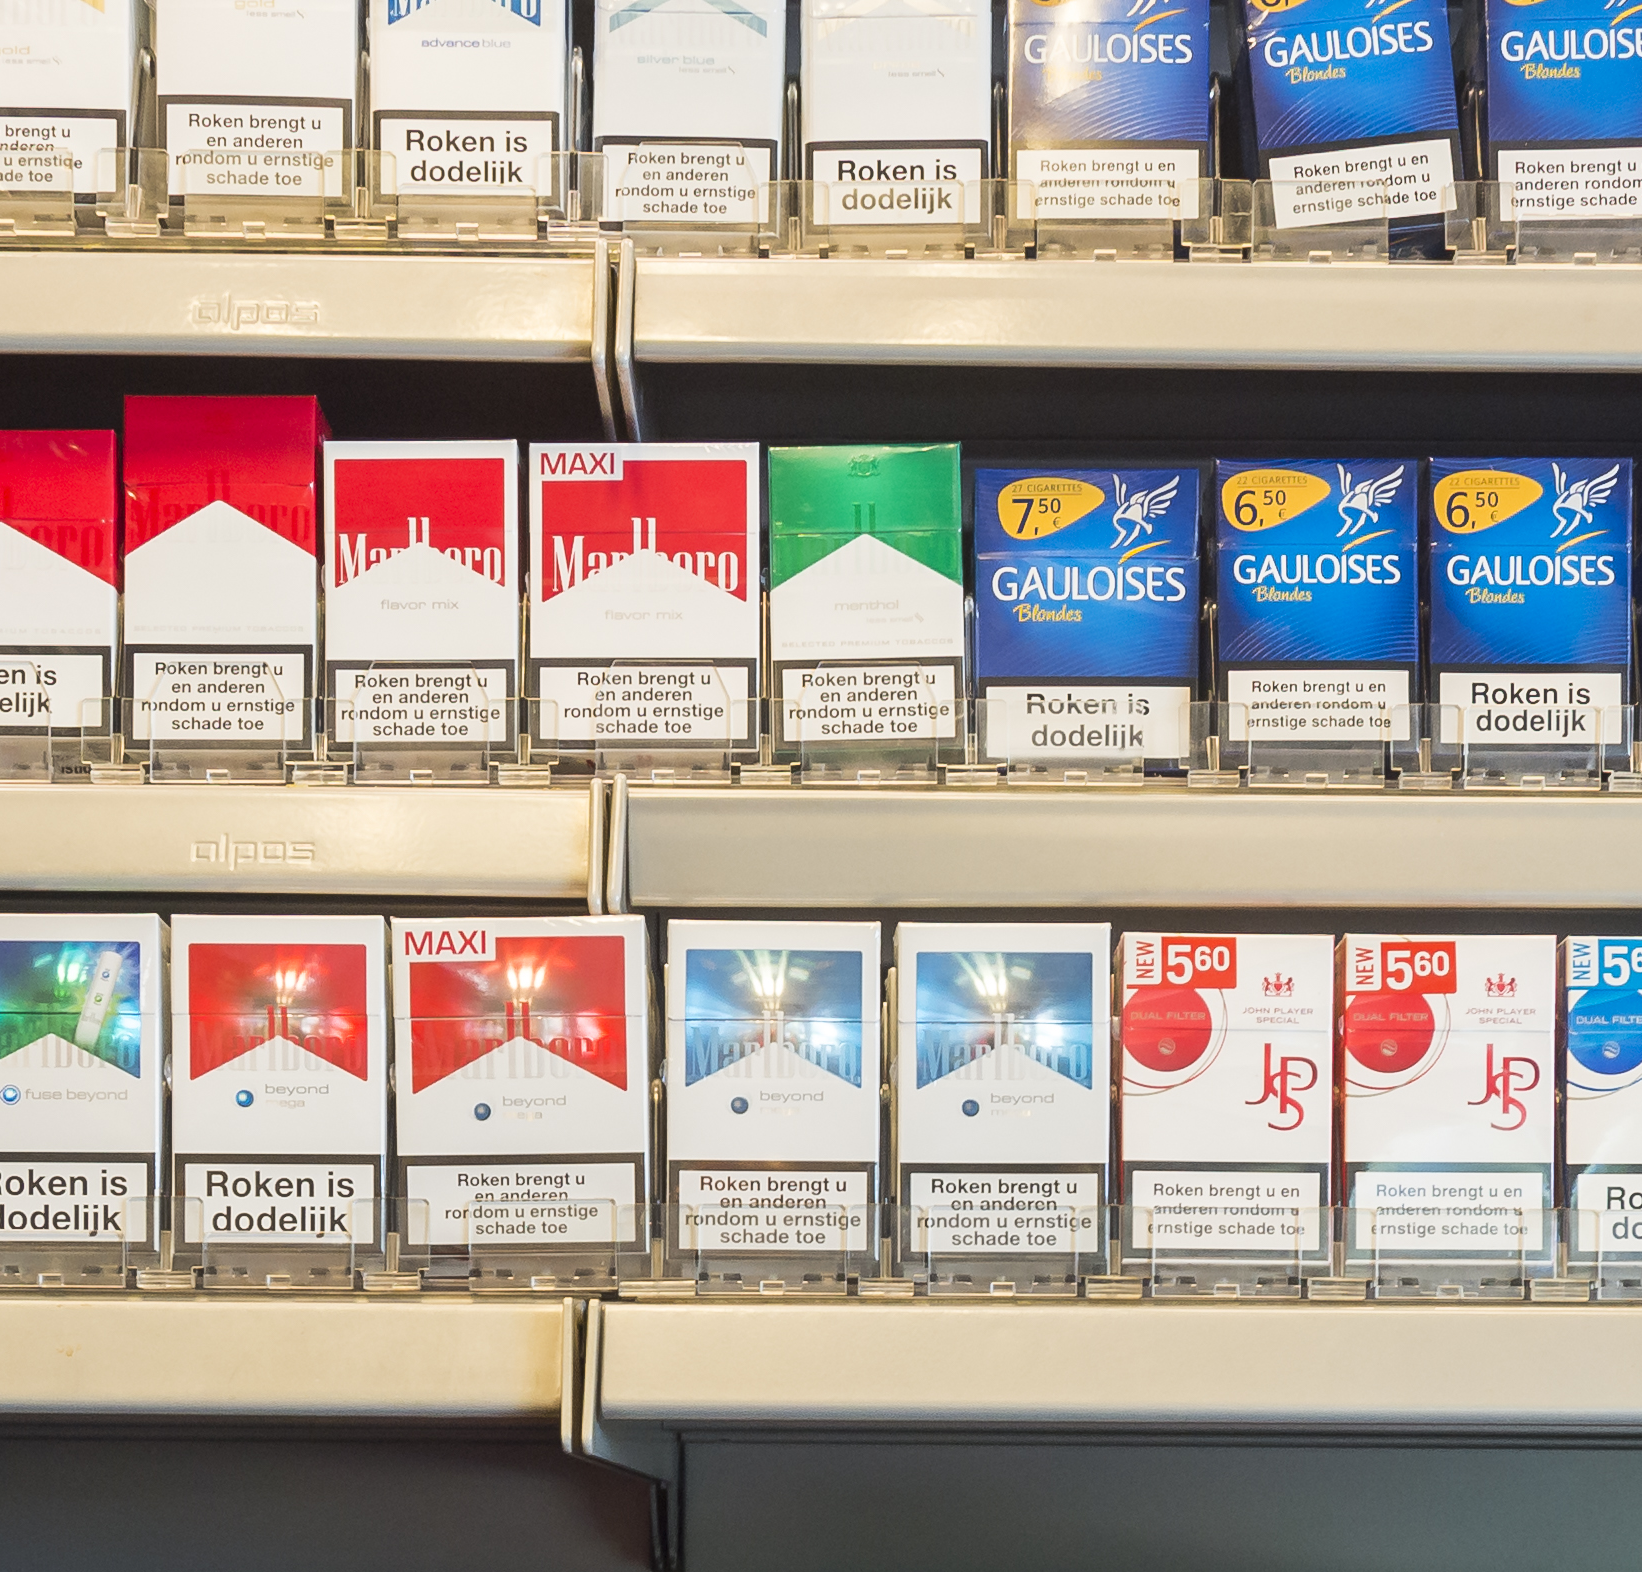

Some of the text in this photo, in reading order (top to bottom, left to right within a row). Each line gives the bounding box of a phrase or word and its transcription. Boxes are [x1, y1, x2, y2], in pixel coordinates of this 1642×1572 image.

[1265, 20, 1434, 69] GAULOISES
[1286, 64, 1346, 84] Blondes
[405, 129, 527, 152] Roken is
[411, 160, 523, 187] dodelijk
[1515, 160, 1563, 175] Roken
[1570, 160, 1622, 178] brengt
[1629, 161, 1638, 174] u
[541, 453, 615, 475] MAXI
[1233, 554, 1401, 585] GAULOISES
[992, 566, 1186, 602] GAULOISES
[1013, 605, 1082, 623] Blondes
[155, 661, 283, 680] Roken brengt u
[171, 680, 265, 694] en anderen
[1472, 682, 1590, 704] Roken is
[212, 702, 221, 712] u
[227, 698, 294, 715] ernstige
[171, 717, 264, 731] schade toe
[1477, 710, 1586, 736] dodelijk
[1574, 943, 1590, 980] NEW
[1576, 1016, 1610, 1024] DUAL
